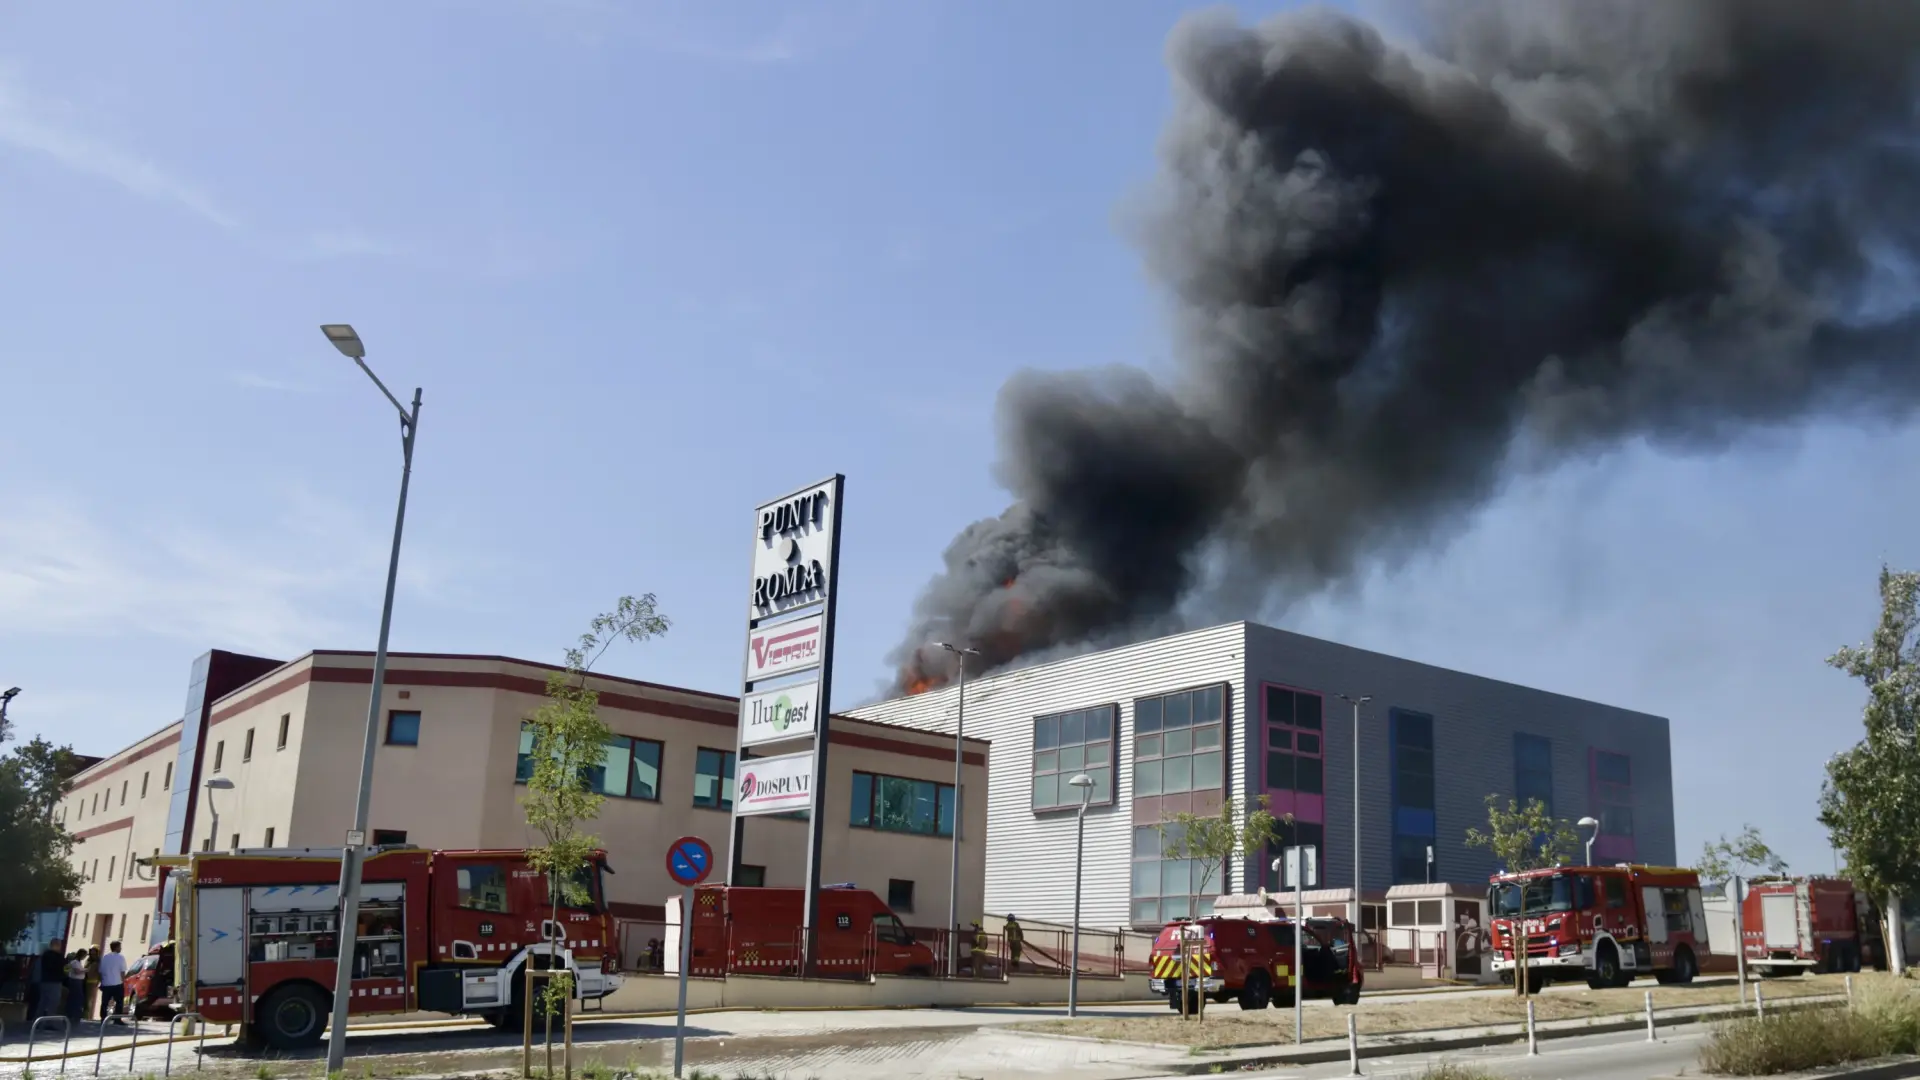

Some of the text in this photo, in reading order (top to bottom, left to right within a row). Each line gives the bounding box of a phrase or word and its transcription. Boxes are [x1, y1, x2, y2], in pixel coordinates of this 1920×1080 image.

[758, 490, 826, 540] PUNT
[752, 559, 823, 607] ROMA
[756, 774, 811, 797] DOSPUNT
[481, 924, 493, 932] 112
[838, 916, 849, 924] 112
